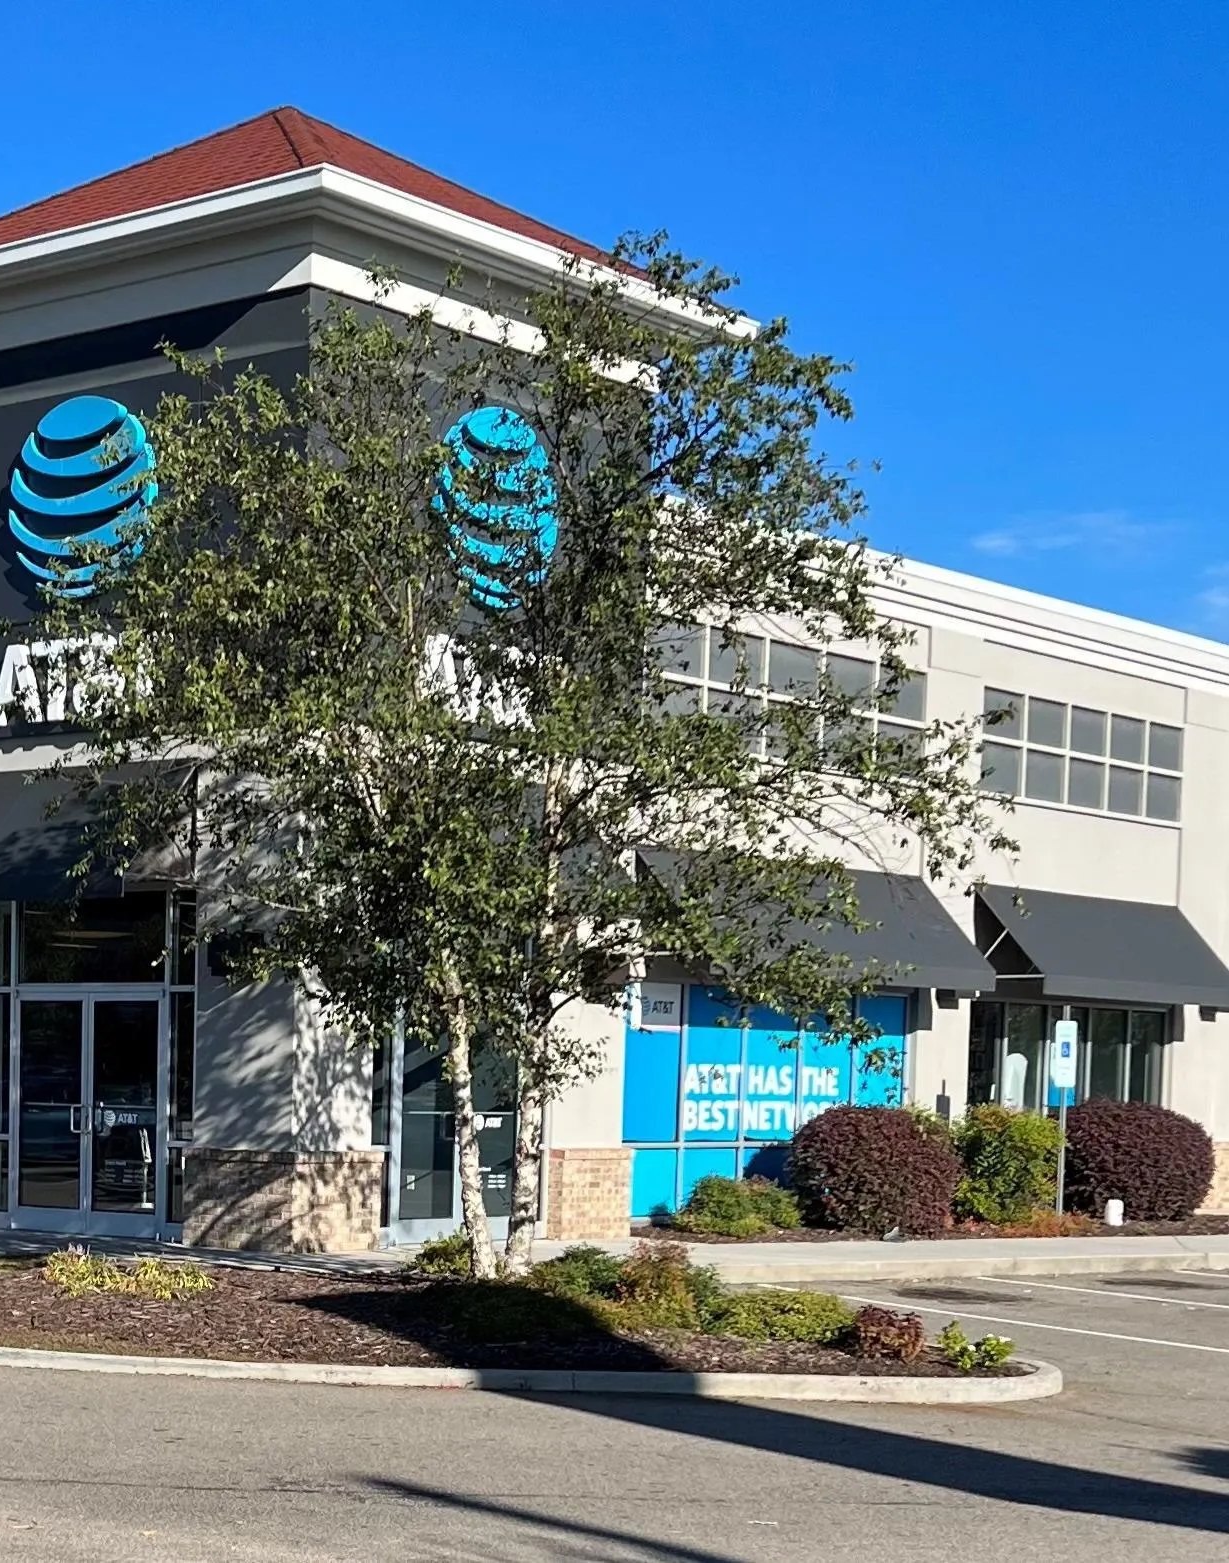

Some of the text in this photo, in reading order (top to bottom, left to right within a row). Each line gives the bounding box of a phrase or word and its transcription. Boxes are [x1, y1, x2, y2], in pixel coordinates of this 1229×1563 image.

[651, 1000, 675, 1014] AT&T
[684, 1064, 840, 1097] AT&T HAS THE
[117, 1112, 139, 1125] AT&T
[683, 1100, 739, 1131] BEST
